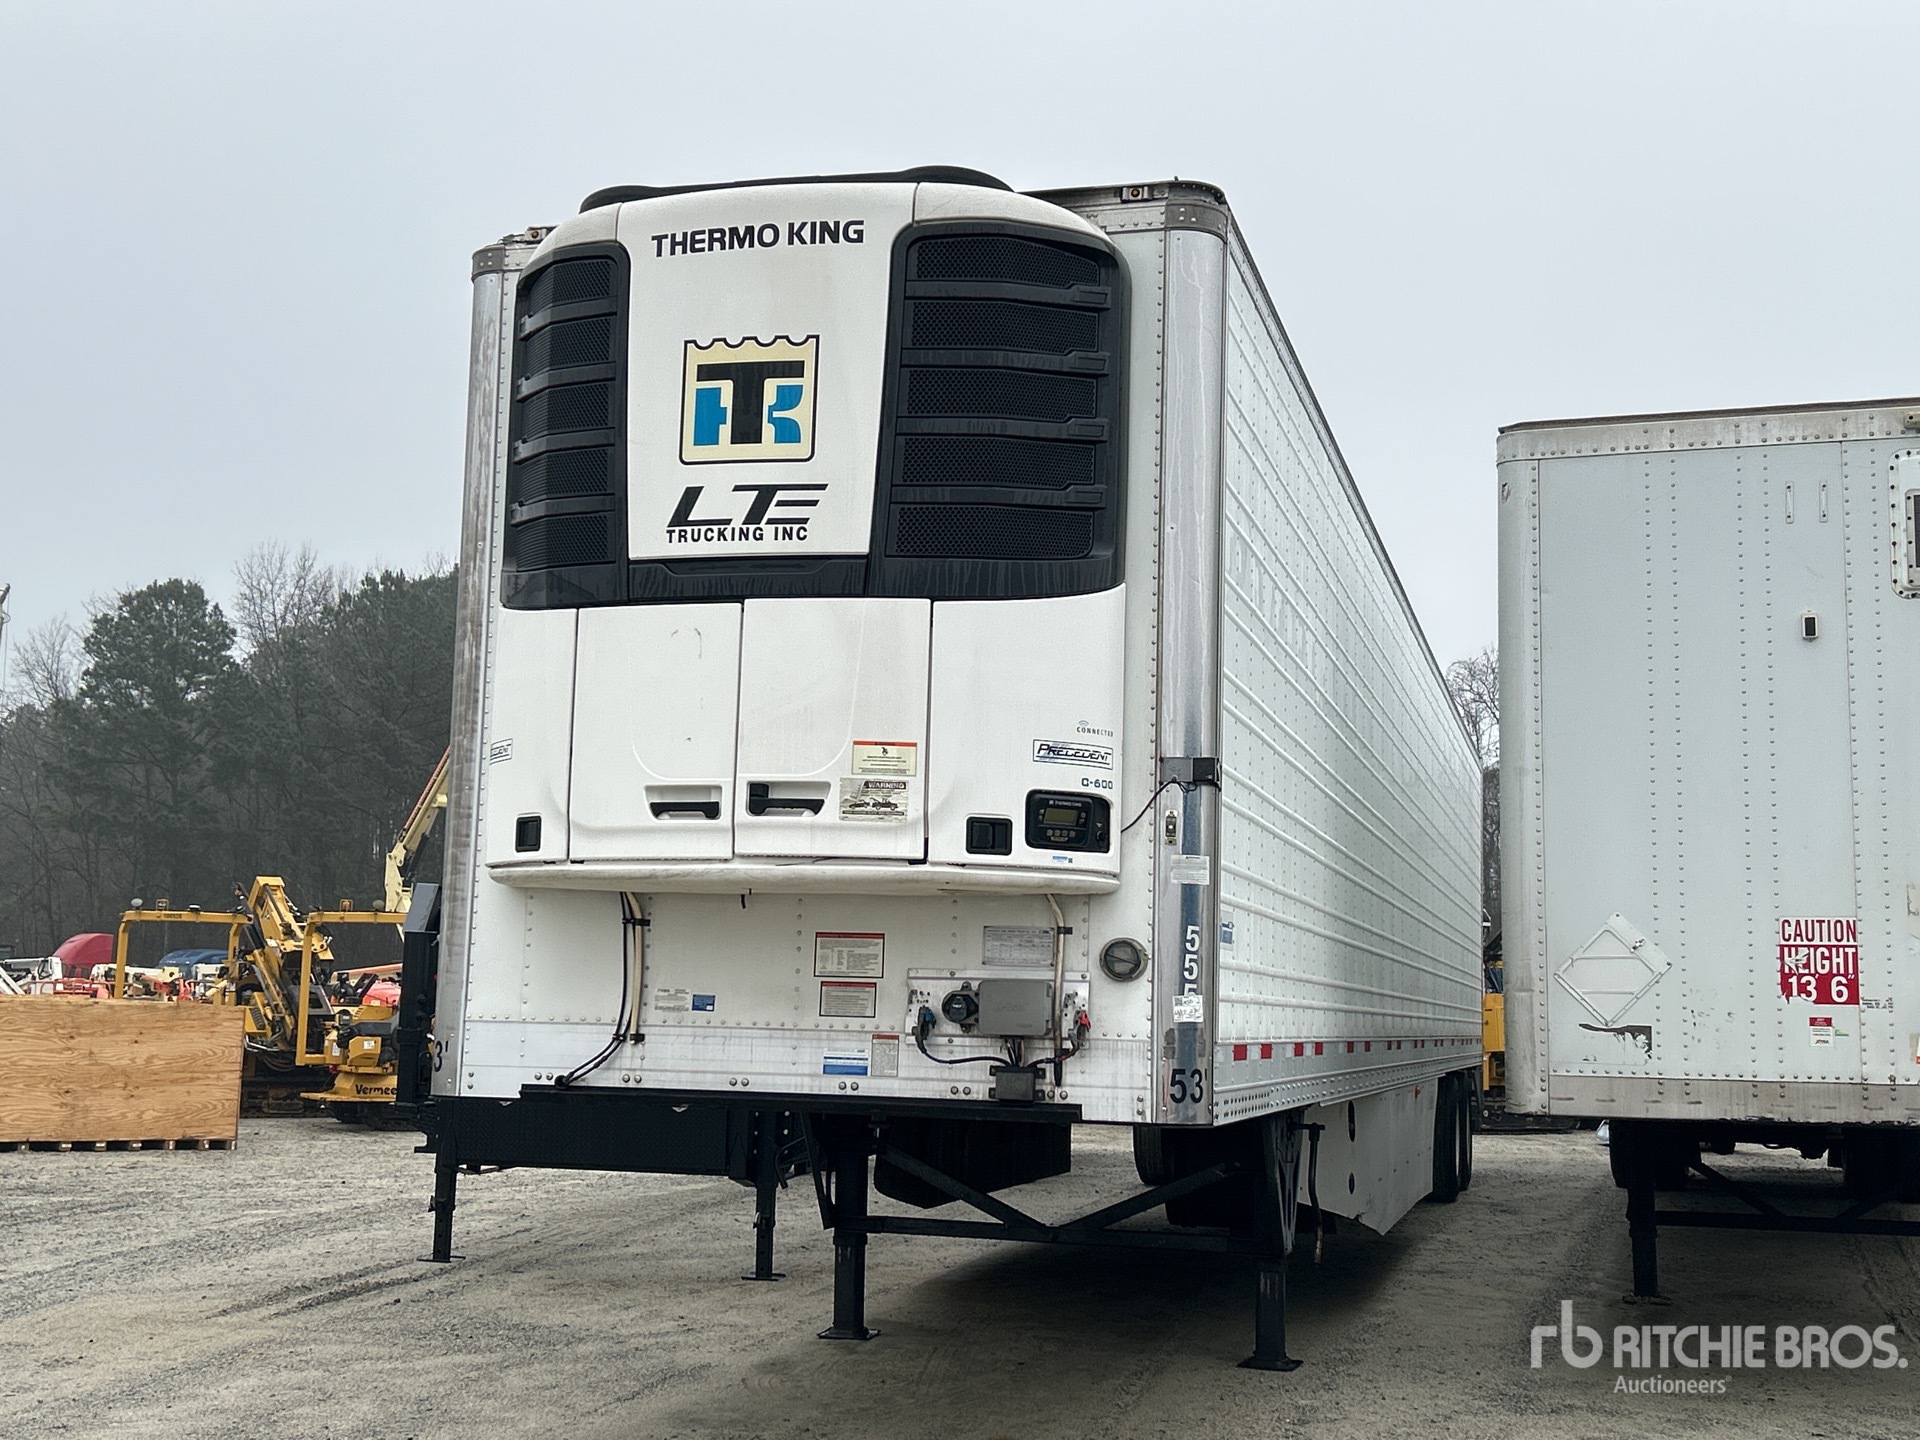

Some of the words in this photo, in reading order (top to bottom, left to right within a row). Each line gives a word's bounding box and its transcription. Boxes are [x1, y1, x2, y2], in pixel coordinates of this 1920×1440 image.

[650, 223, 780, 258] THERMO
[786, 219, 864, 245] KING
[666, 526, 764, 543] TRUCKING
[774, 526, 808, 541] INC
[1076, 726, 1113, 737] CONNECTED
[1037, 743, 1111, 761] PRECEDENT
[1081, 777, 1113, 789] C-600
[1781, 919, 1857, 943] CAUTION
[434, 1040, 449, 1072] 3'
[355, 1084, 397, 1095] Vermee
